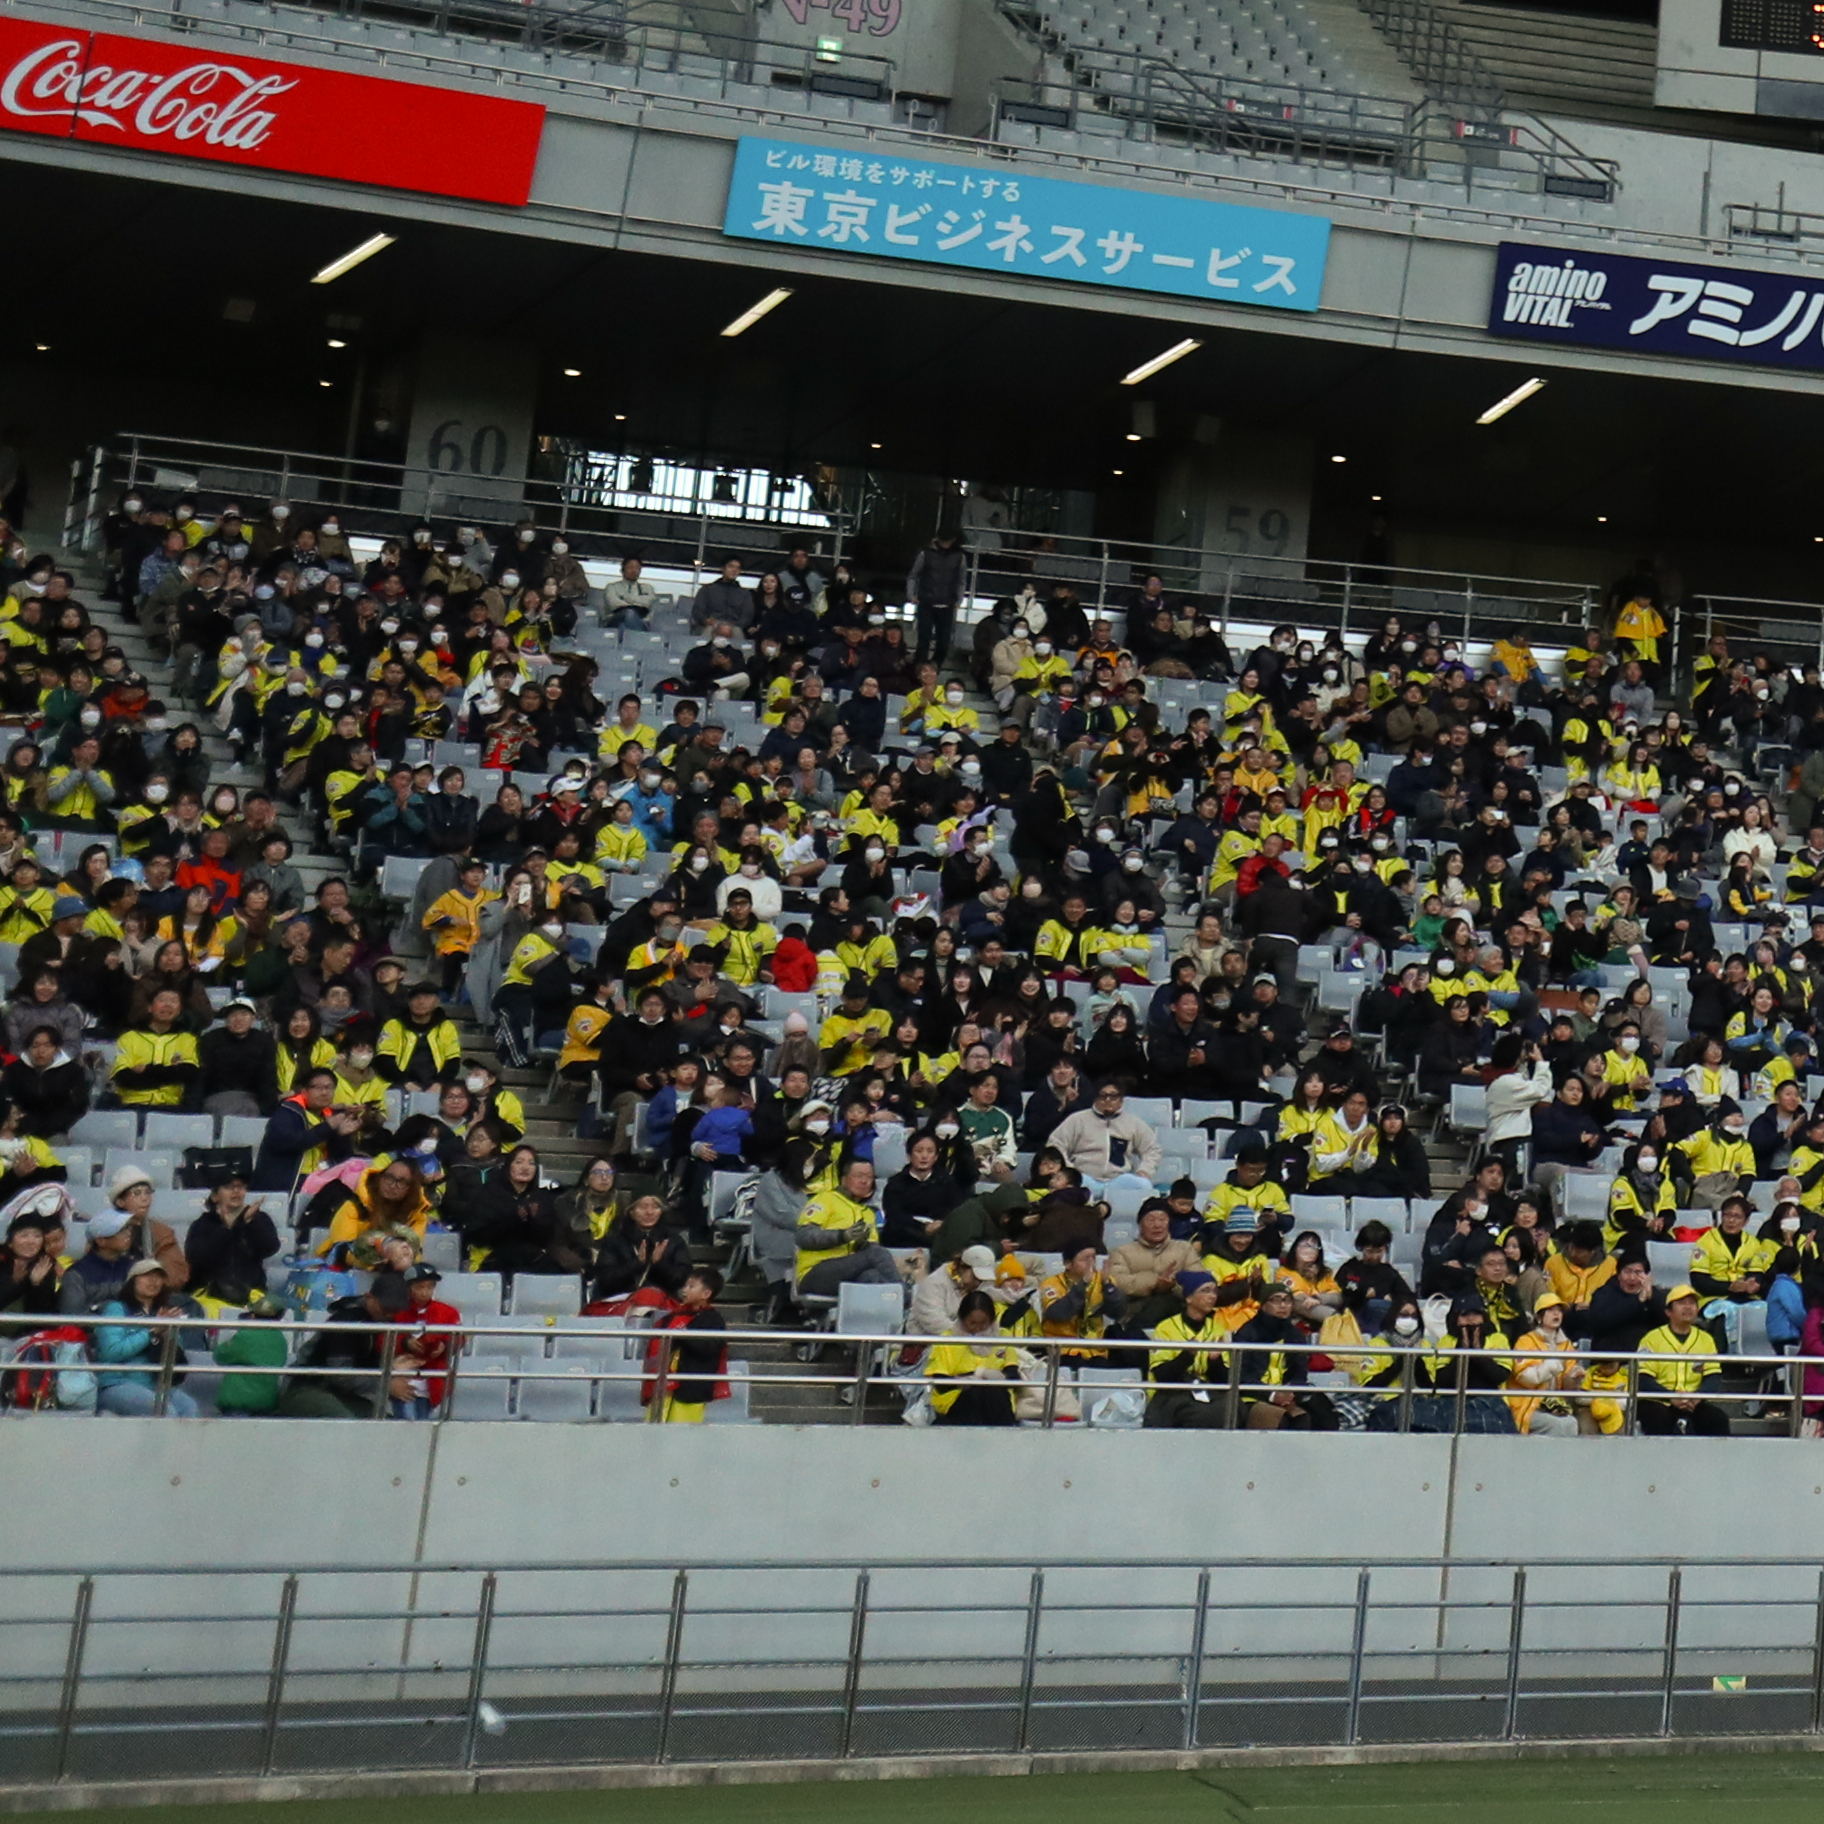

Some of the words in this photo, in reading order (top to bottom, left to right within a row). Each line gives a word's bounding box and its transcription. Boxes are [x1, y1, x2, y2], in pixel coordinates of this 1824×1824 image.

[1, 40, 298, 151] Coca-Cola
[764, 148, 1022, 204] ビル環境をサポートする
[752, 180, 1298, 296] 東京ビジネスサービス
[1508, 259, 1608, 301] amino
[1503, 292, 1571, 328] VITAL
[427, 419, 508, 476] 60
[1225, 505, 1291, 559] 59
